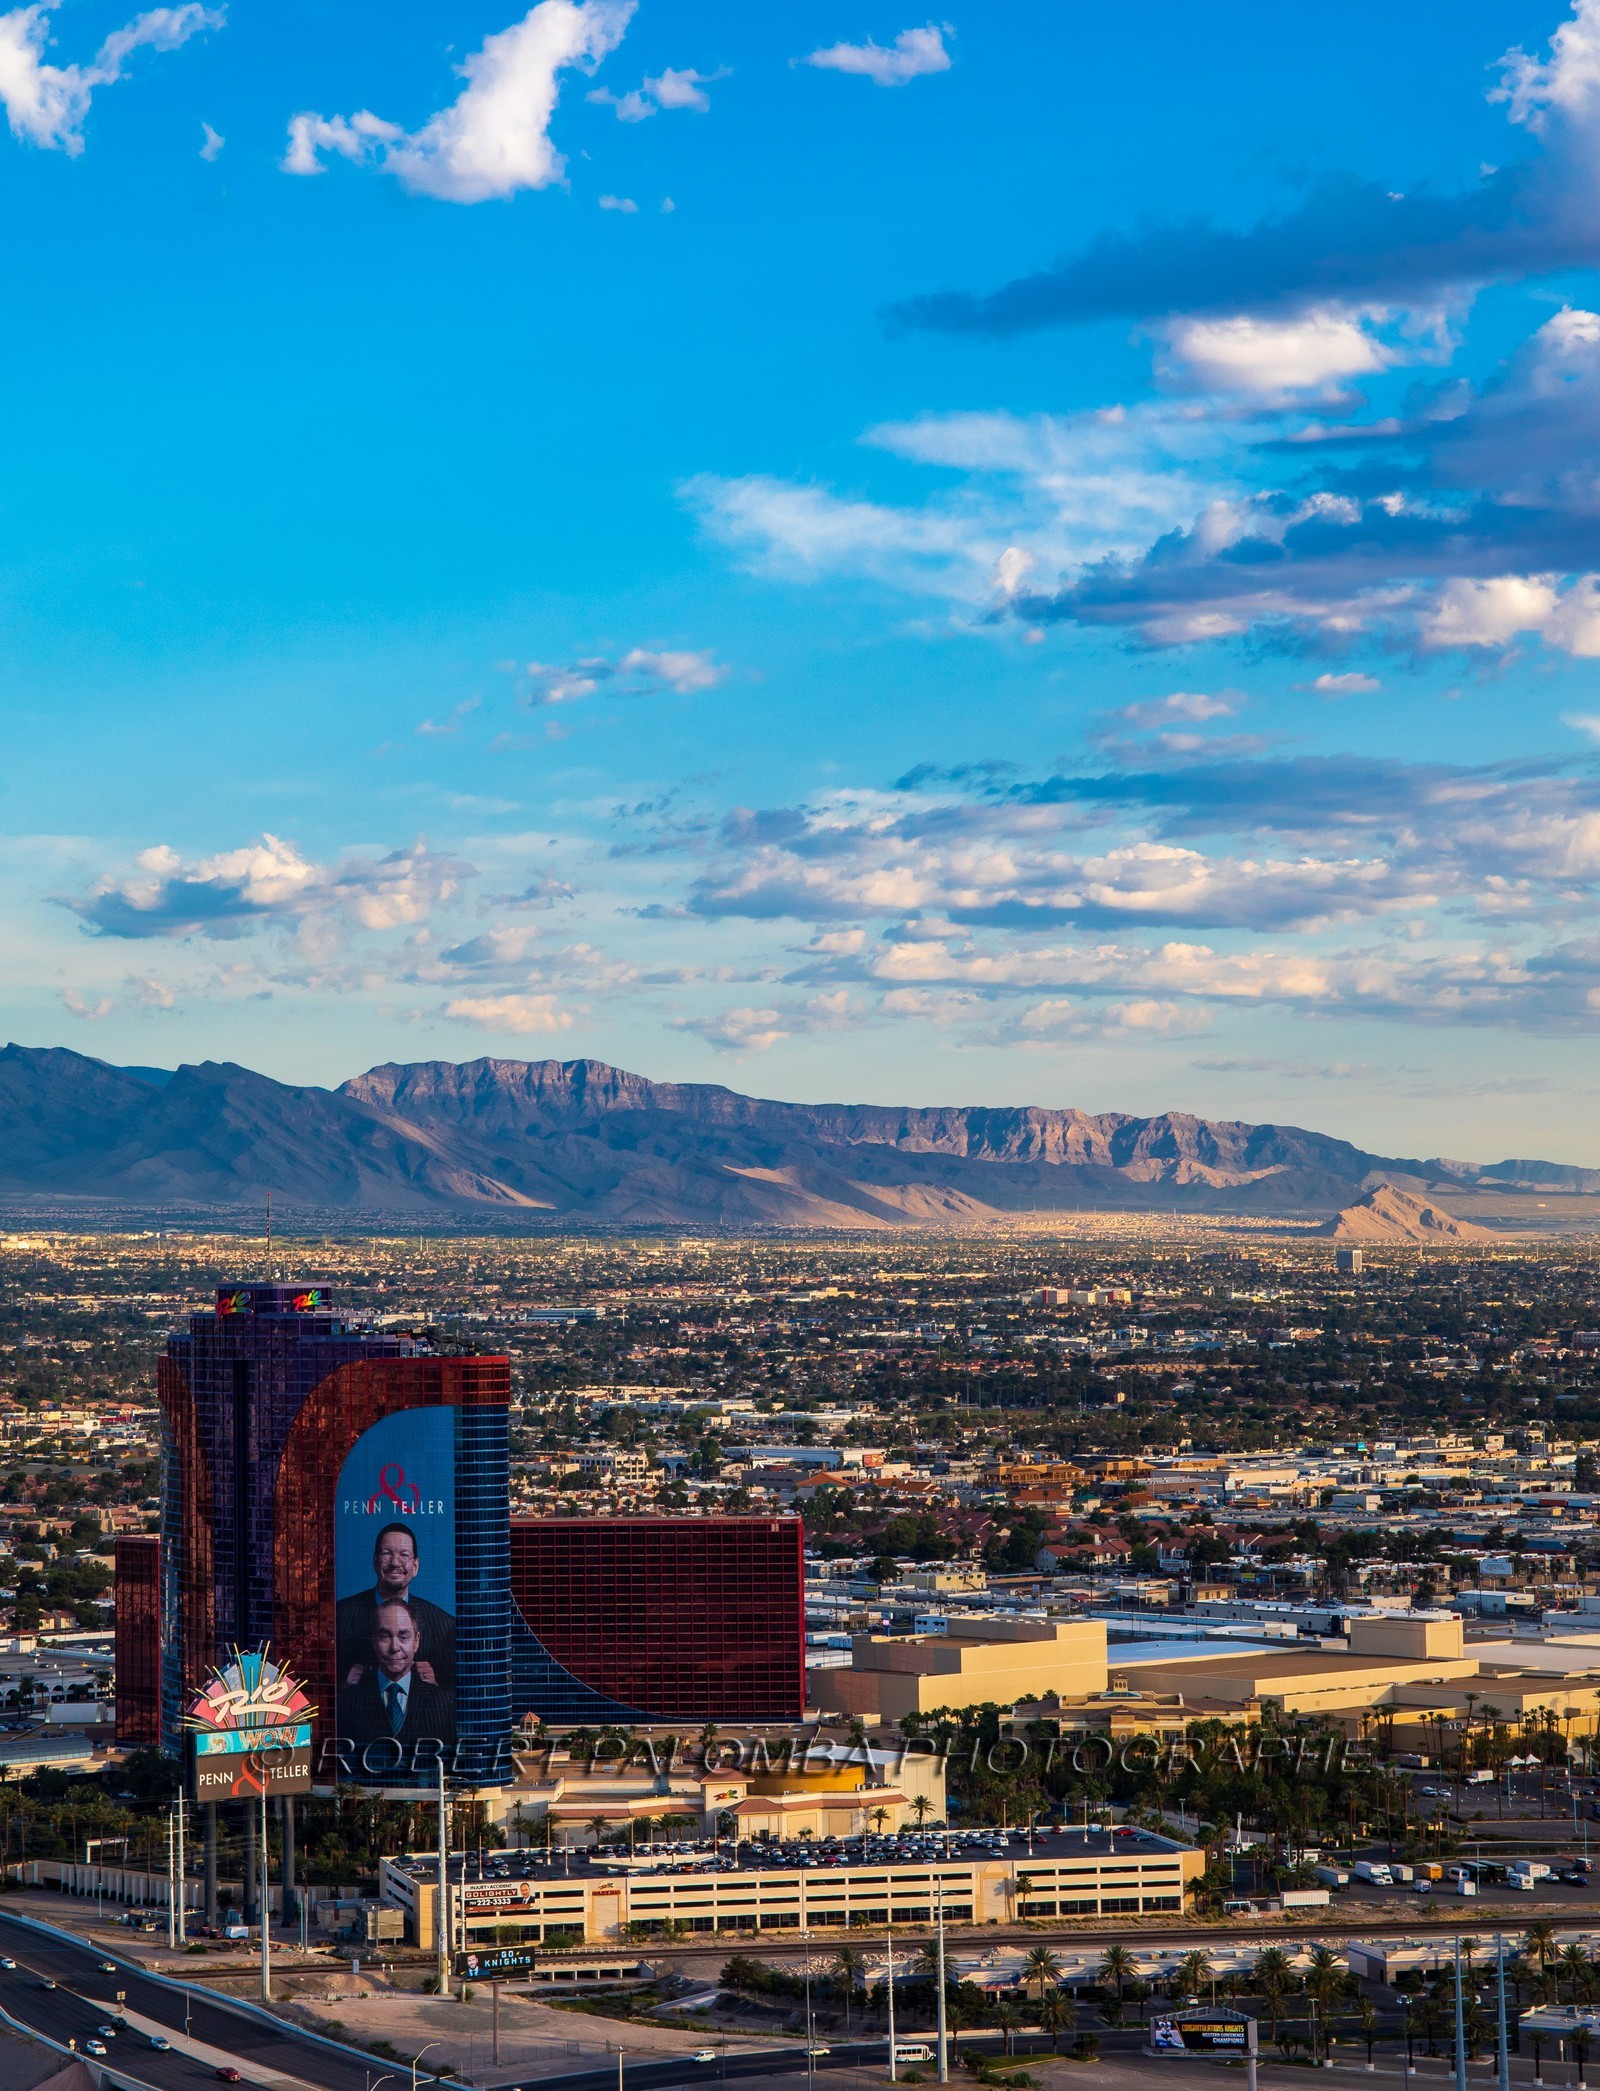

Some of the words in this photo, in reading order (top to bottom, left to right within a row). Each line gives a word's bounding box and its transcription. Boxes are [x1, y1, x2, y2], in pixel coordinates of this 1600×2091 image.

[292, 1289, 323, 1312] Rio
[344, 1500, 382, 1515] PENN
[392, 1500, 444, 1515] TELLER
[208, 1678, 292, 1723] Rio
[239, 1727, 299, 1749] WOW
[199, 1771, 234, 1787] PENN
[269, 1764, 309, 1780] TELLER
[465, 1889, 517, 1898] GOLIGHTLY
[476, 1898, 511, 1906] 222-3333
[501, 1950, 514, 1958] GO
[484, 1956, 531, 1968] KNIGHTS
[1224, 2024, 1245, 2033] KNIGHTS
